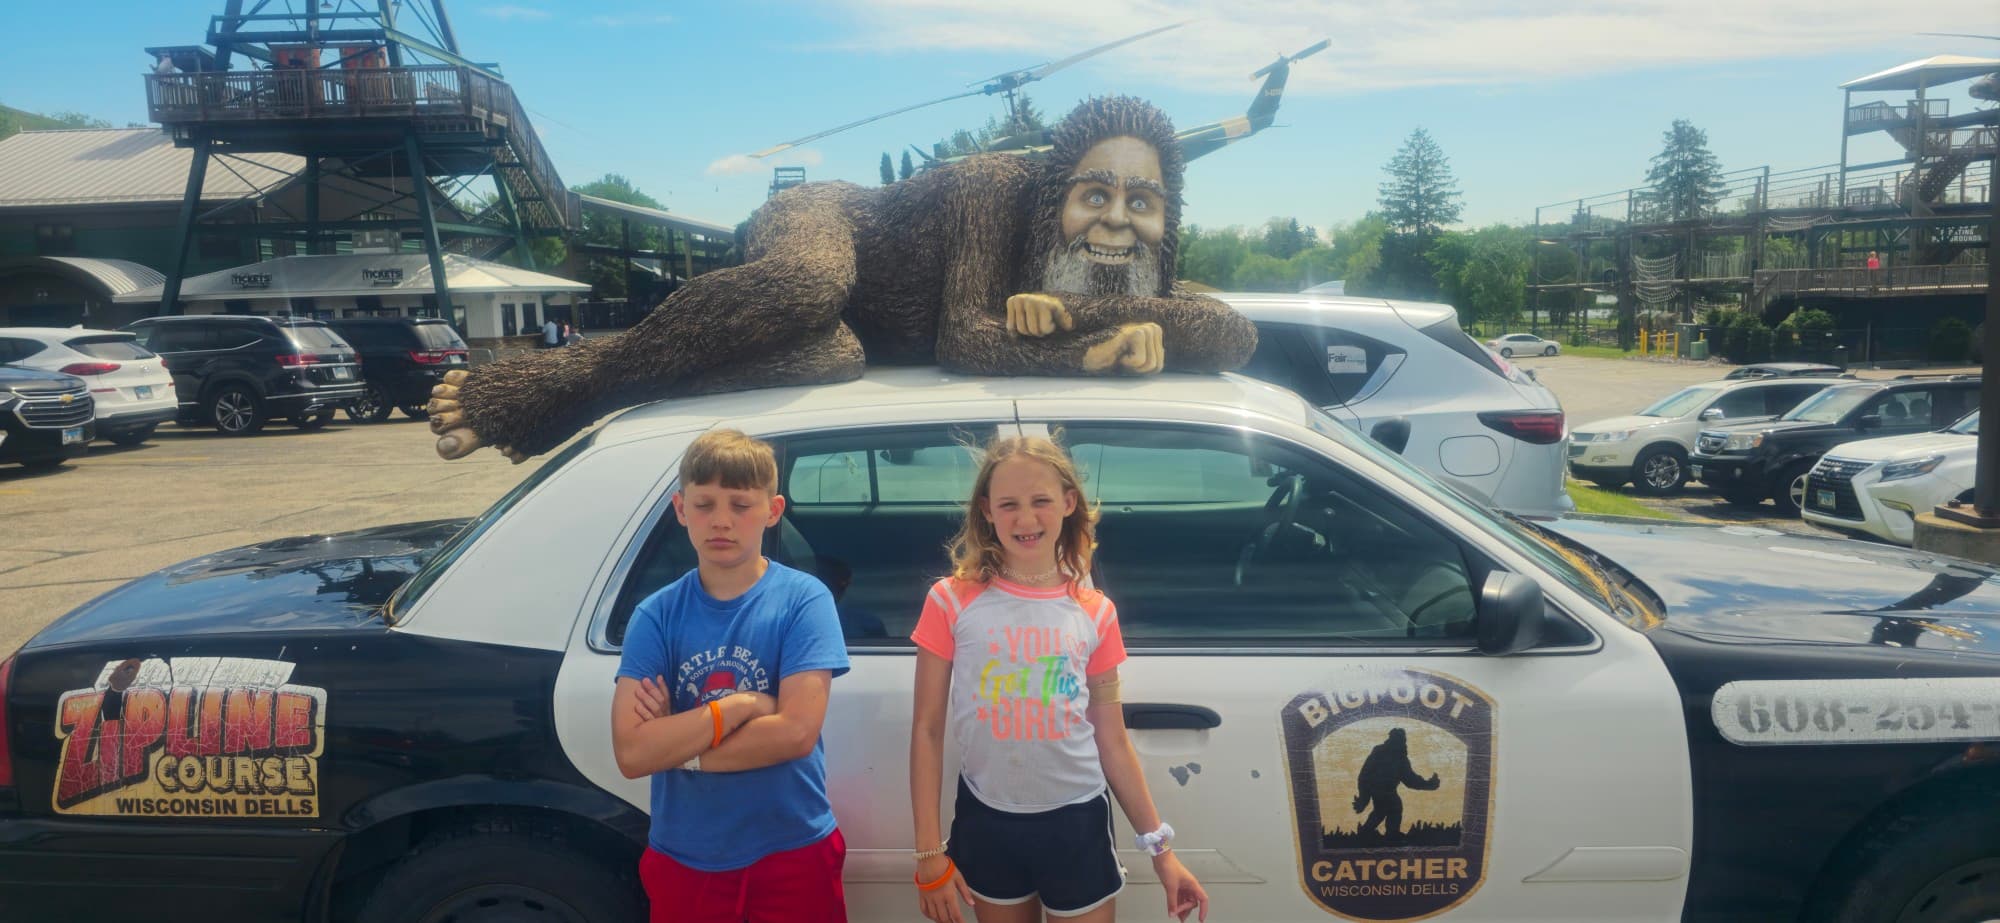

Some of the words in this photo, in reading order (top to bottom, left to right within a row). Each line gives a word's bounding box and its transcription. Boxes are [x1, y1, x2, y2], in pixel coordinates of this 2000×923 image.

[232, 273, 272, 284] TICKETS
[362, 269, 403, 280] TICKETS
[1003, 625, 1062, 664] YOU
[675, 645, 728, 699] RTLE
[732, 645, 769, 691] BEACH
[979, 658, 1031, 705] Got
[1036, 653, 1080, 708] This
[1736, 695, 2000, 733] 608-254-
[58, 685, 314, 806] ZIPLINE
[154, 754, 315, 795] COURSE
[116, 797, 237, 815] WISCONSIN
[244, 797, 314, 815] DELLS
[1311, 858, 1468, 882] CATCHER
[1320, 885, 1407, 897] WISCONSIN
[1411, 883, 1459, 896] DELLS
